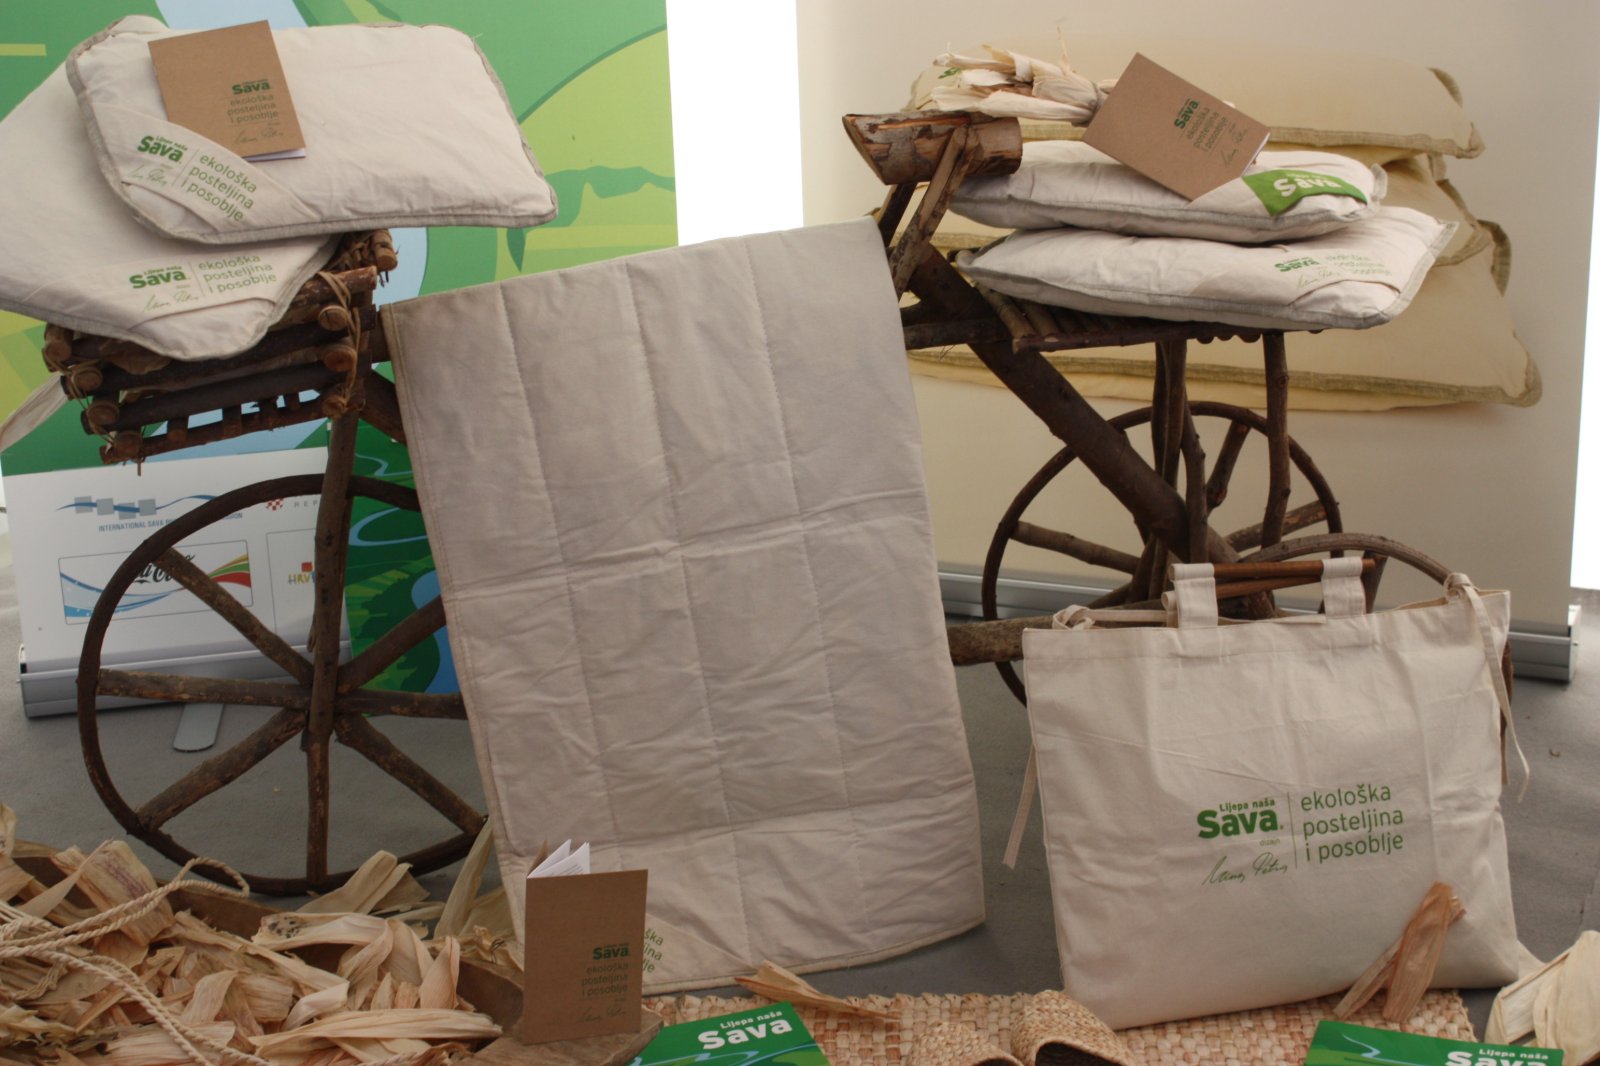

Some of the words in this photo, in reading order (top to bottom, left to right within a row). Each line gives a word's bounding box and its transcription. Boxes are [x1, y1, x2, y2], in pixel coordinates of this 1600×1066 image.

[231, 82, 270, 95] Sava
[1174, 100, 1199, 129] Sava
[137, 135, 183, 162] Sava
[200, 155, 257, 193] ekološka
[189, 166, 254, 209] posteljina
[1273, 178, 1342, 197] Sava
[186, 183, 244, 221] posoblje
[198, 255, 261, 270] ekološka
[129, 270, 187, 289] Sava
[203, 263, 273, 283] posteljina
[216, 273, 277, 293] posoblje
[99, 522, 147, 533] INTERNATIONAL
[147, 519, 165, 528] SAVA
[1219, 802, 1249, 813] Lijepa
[1252, 797, 1275, 808] naša
[1301, 784, 1391, 812] ekološka
[1197, 809, 1278, 839] Sava
[1303, 808, 1404, 841] posteljina
[1305, 842, 1310, 862] i
[1318, 831, 1404, 864] posoblje
[592, 946, 630, 960] Sava
[720, 1018, 754, 1029] Lijepa
[698, 1019, 793, 1050] Sava
[1445, 1051, 1547, 1066] Sav
[1479, 1049, 1516, 1058] Lijepa
